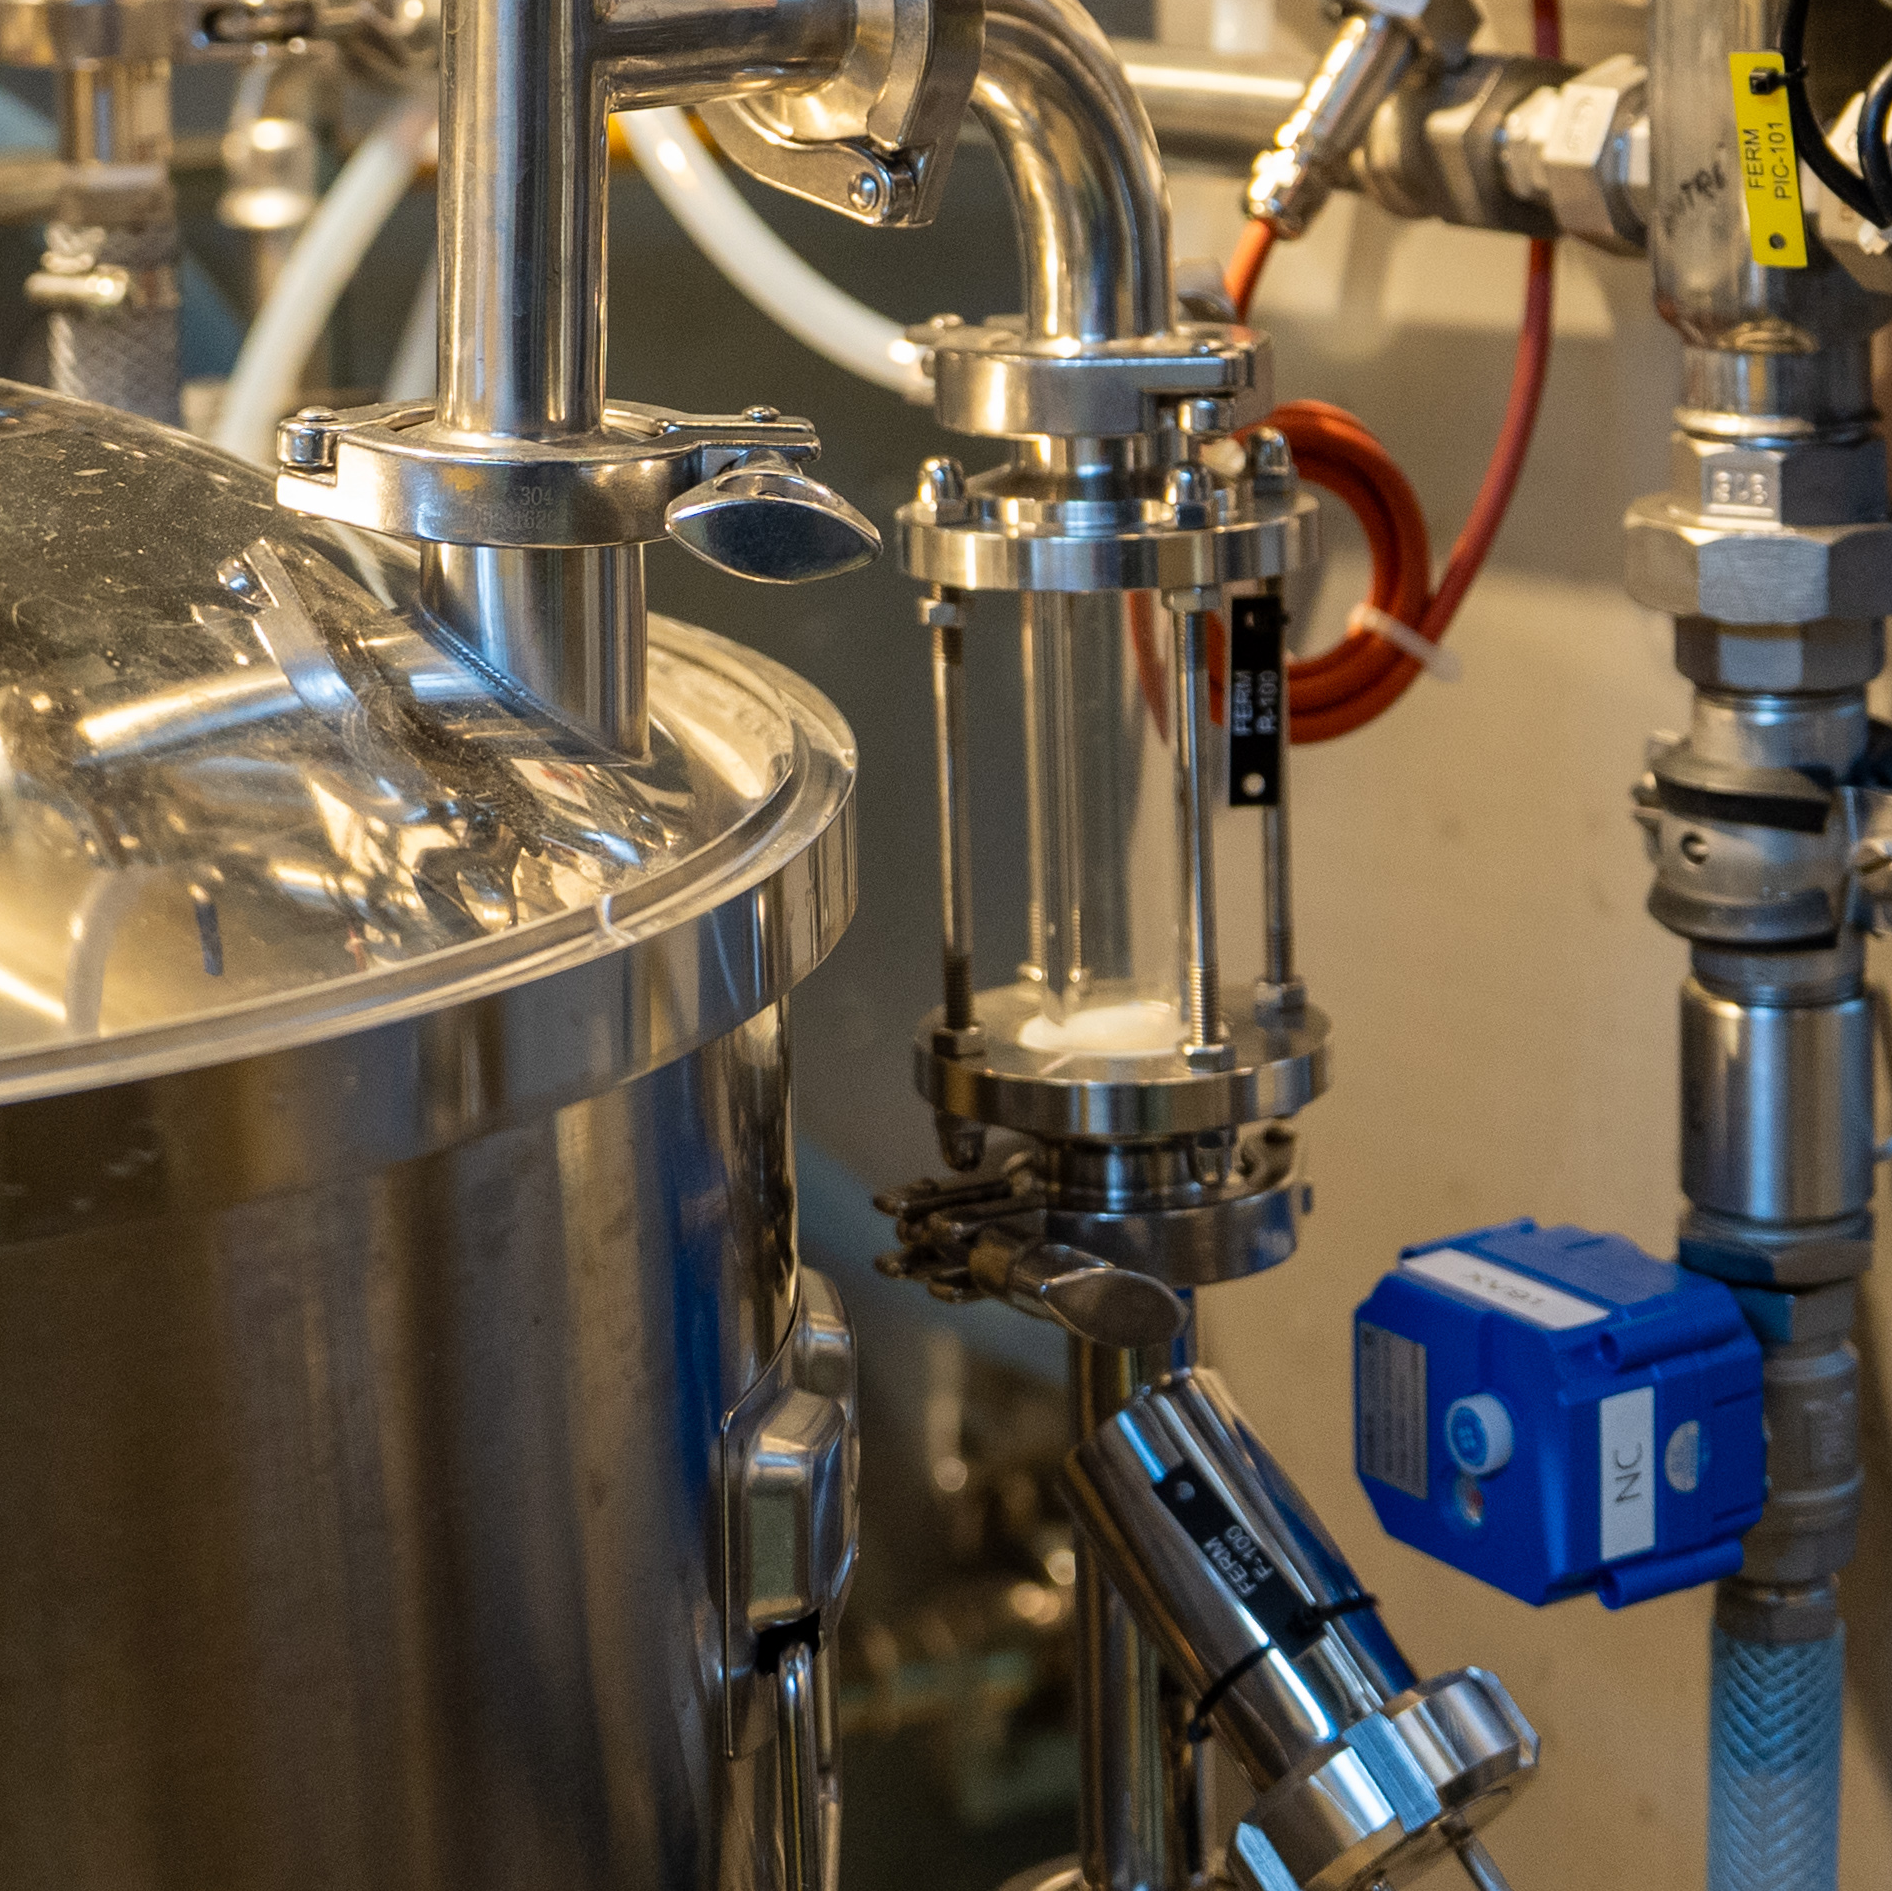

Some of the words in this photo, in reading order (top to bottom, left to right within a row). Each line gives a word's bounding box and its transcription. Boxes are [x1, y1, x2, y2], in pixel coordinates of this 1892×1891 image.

[1743, 129, 1765, 189] FERM
[1767, 122, 1792, 199] PIC-101
[1232, 670, 1253, 736] FERM
[1256, 670, 1278, 735] R-100
[1615, 1440, 1642, 1503] NC
[1204, 1536, 1257, 1598] FERM
[1224, 1525, 1274, 1582] F-100
